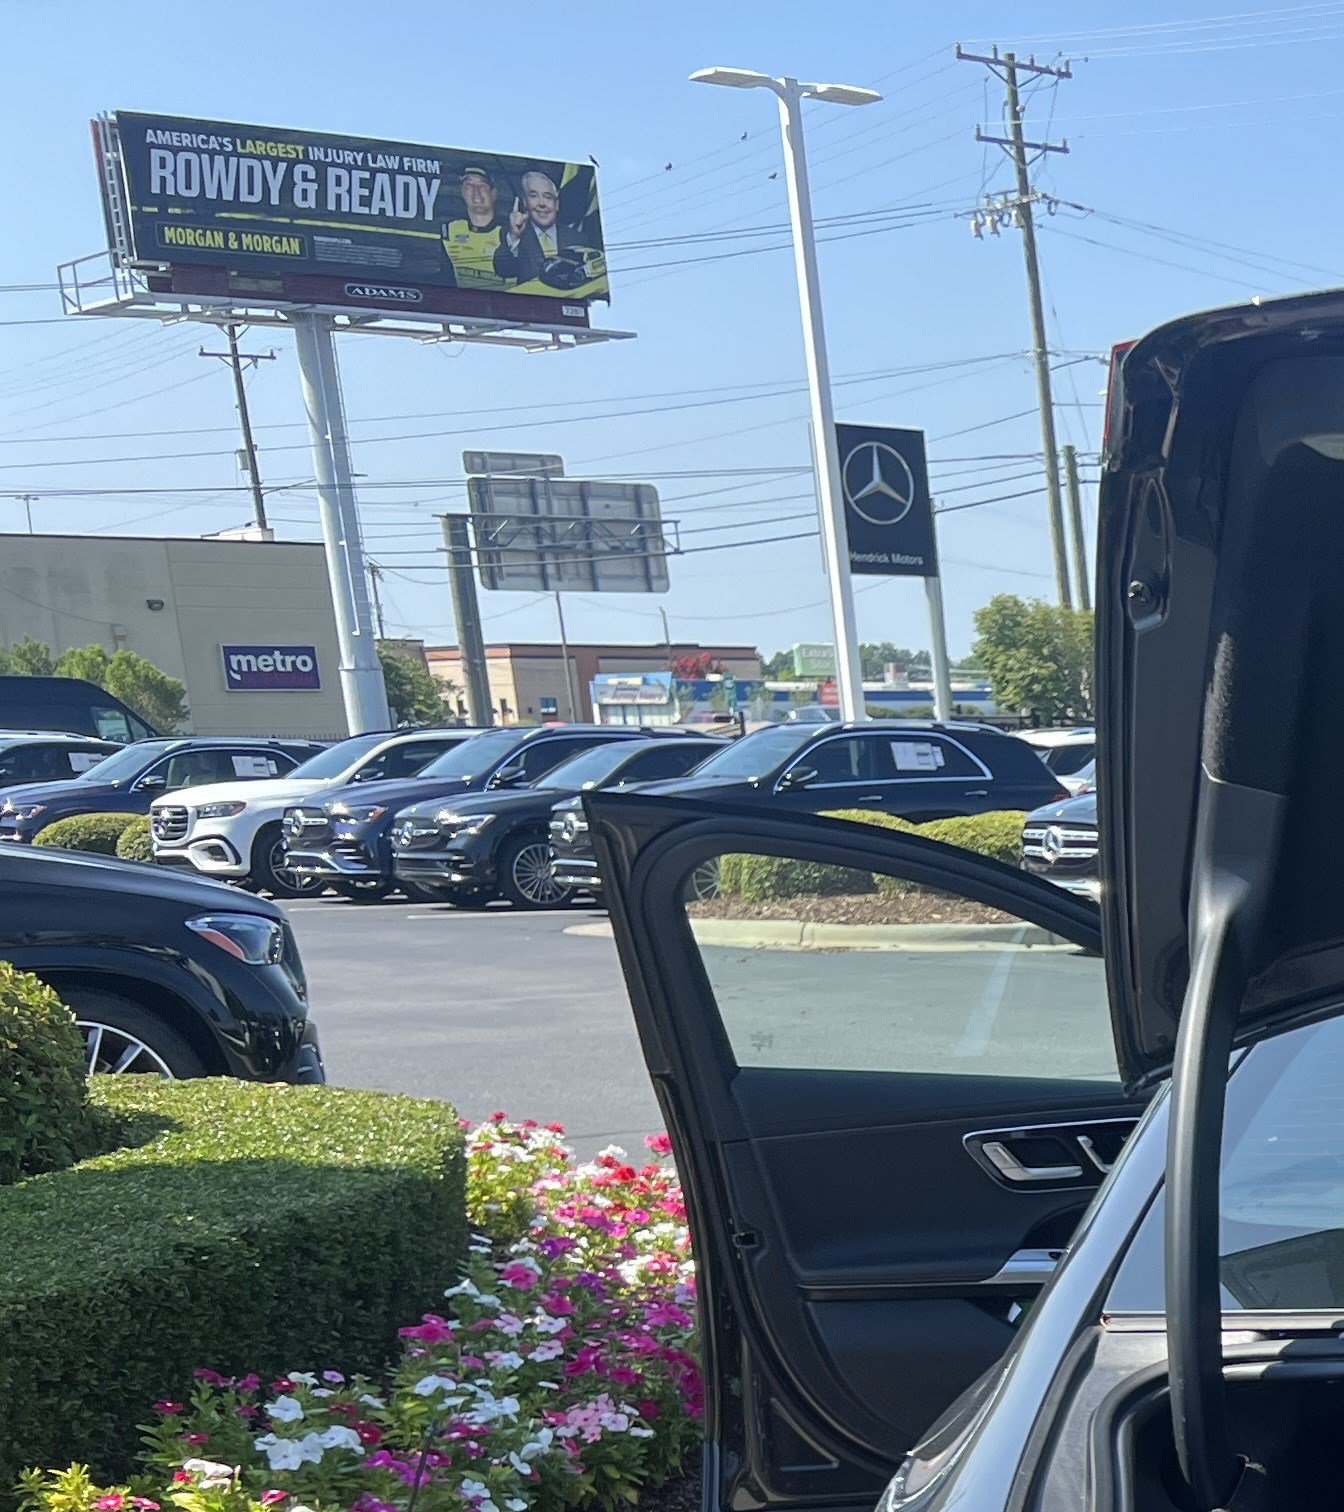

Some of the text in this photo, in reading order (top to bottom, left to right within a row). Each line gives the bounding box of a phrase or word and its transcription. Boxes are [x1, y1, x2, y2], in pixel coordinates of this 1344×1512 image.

[145, 128, 441, 175] AMERICA'S LARGEST INJURY LAW FIRM
[150, 148, 441, 221] ROWDY & READY
[164, 226, 225, 249] MORGAN
[227, 231, 239, 250] &
[241, 233, 301, 255] MORGAN
[351, 286, 418, 300] ADAMS
[229, 650, 313, 680] metro
